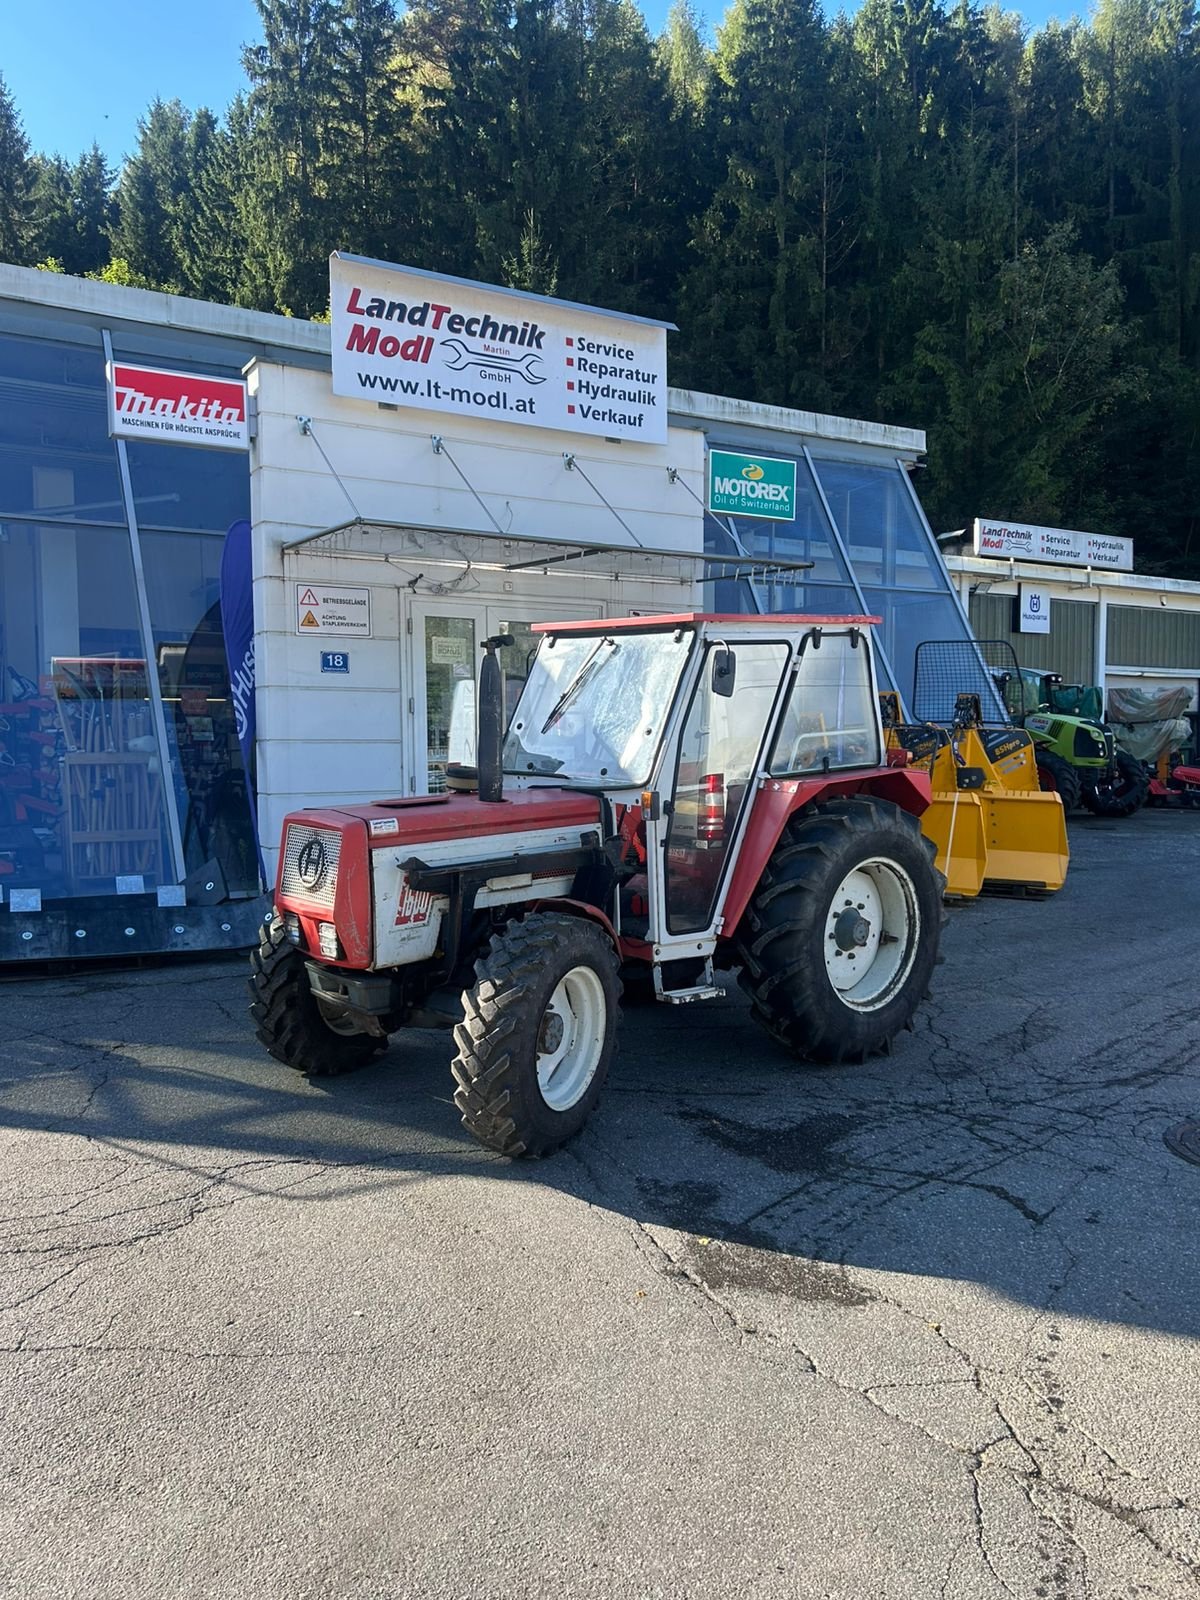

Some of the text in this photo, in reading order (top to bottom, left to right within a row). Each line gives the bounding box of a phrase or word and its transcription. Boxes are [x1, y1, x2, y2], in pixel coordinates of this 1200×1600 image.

[346, 287, 546, 350] LandTechnik
[346, 323, 435, 364] Modl
[483, 344, 511, 356] Martin
[577, 337, 635, 361] Service
[479, 369, 512, 384] GmbH
[577, 358, 658, 385] Reparatur
[357, 372, 536, 414] www.lt-modl.at
[577, 380, 657, 406] Hydraulik
[579, 403, 644, 428] Verkauf
[121, 417, 241, 439] MASCHINEN FÜR HÖCHSTE ANSPRÜCHE
[714, 476, 789, 502] MOTOREX
[714, 494, 790, 512] Oil of Switzerland
[982, 525, 1032, 541] LandTechnik
[1046, 534, 1071, 546] Service
[982, 537, 1003, 549] Modl
[1092, 539, 1125, 551] Hydraulik
[1045, 546, 1081, 559] Reparatur
[1092, 552, 1120, 563] Verkauf
[326, 654, 343, 667] 18
